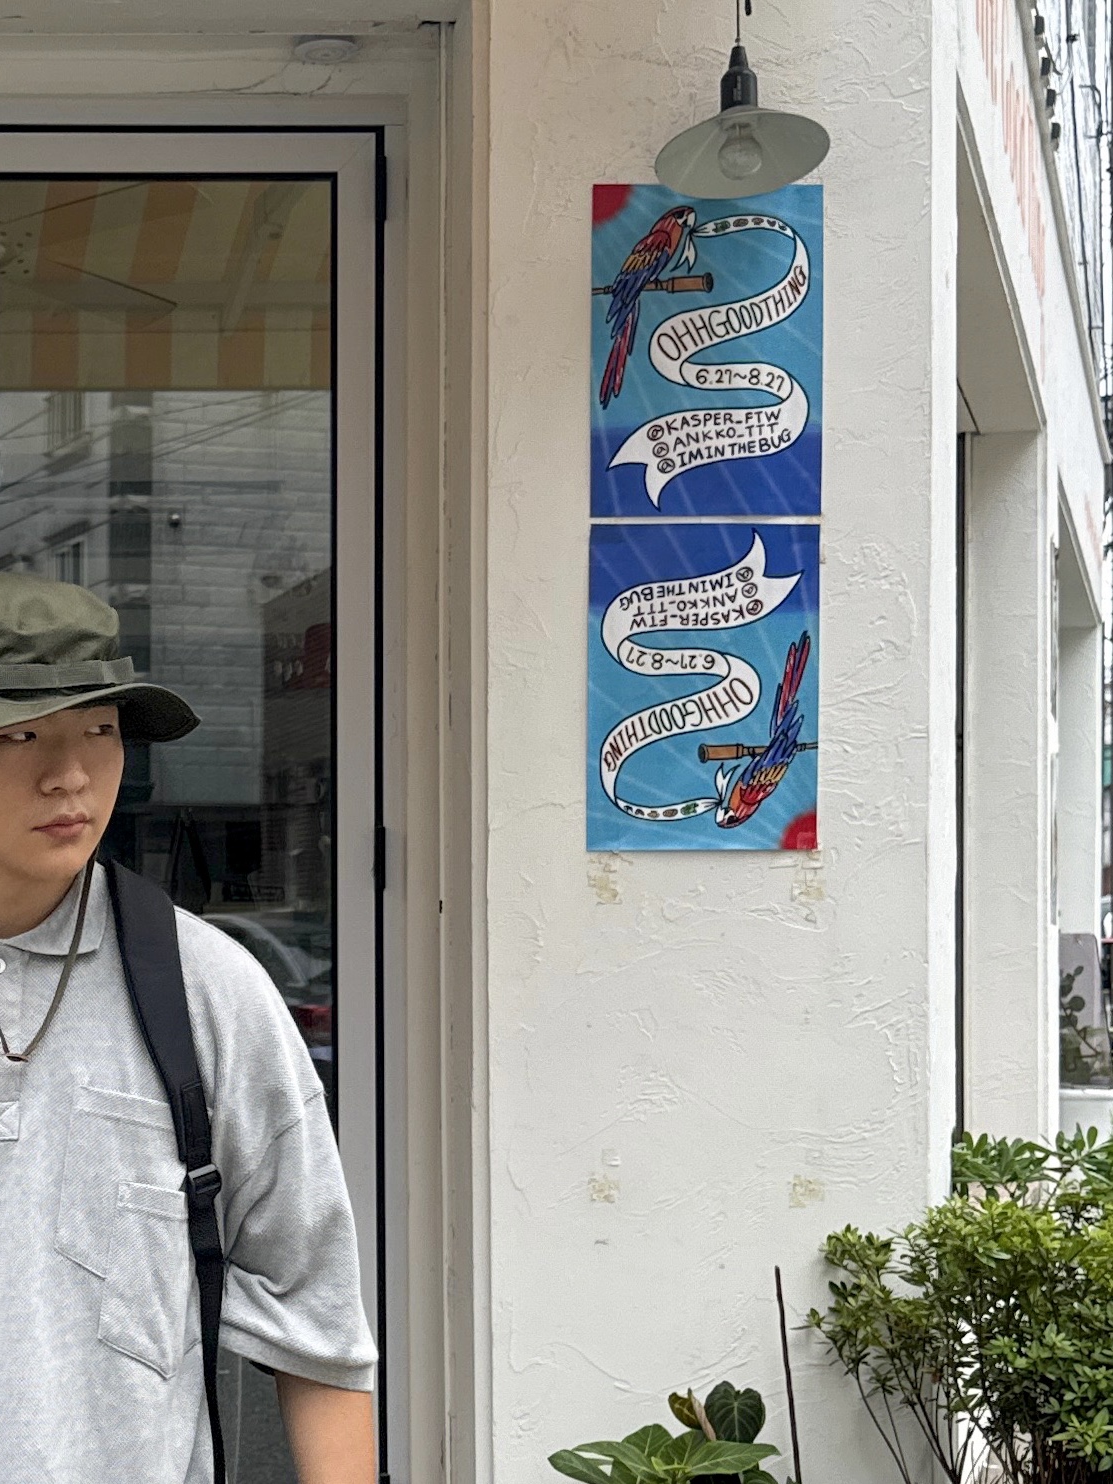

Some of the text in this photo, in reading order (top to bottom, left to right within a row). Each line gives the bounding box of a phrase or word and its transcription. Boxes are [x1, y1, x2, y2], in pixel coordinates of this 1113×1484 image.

[656, 265, 807, 361] OHHGOODTHING
[696, 368, 784, 394] 6.27~8.27
[604, 678, 754, 773] OHHGOODTHING
